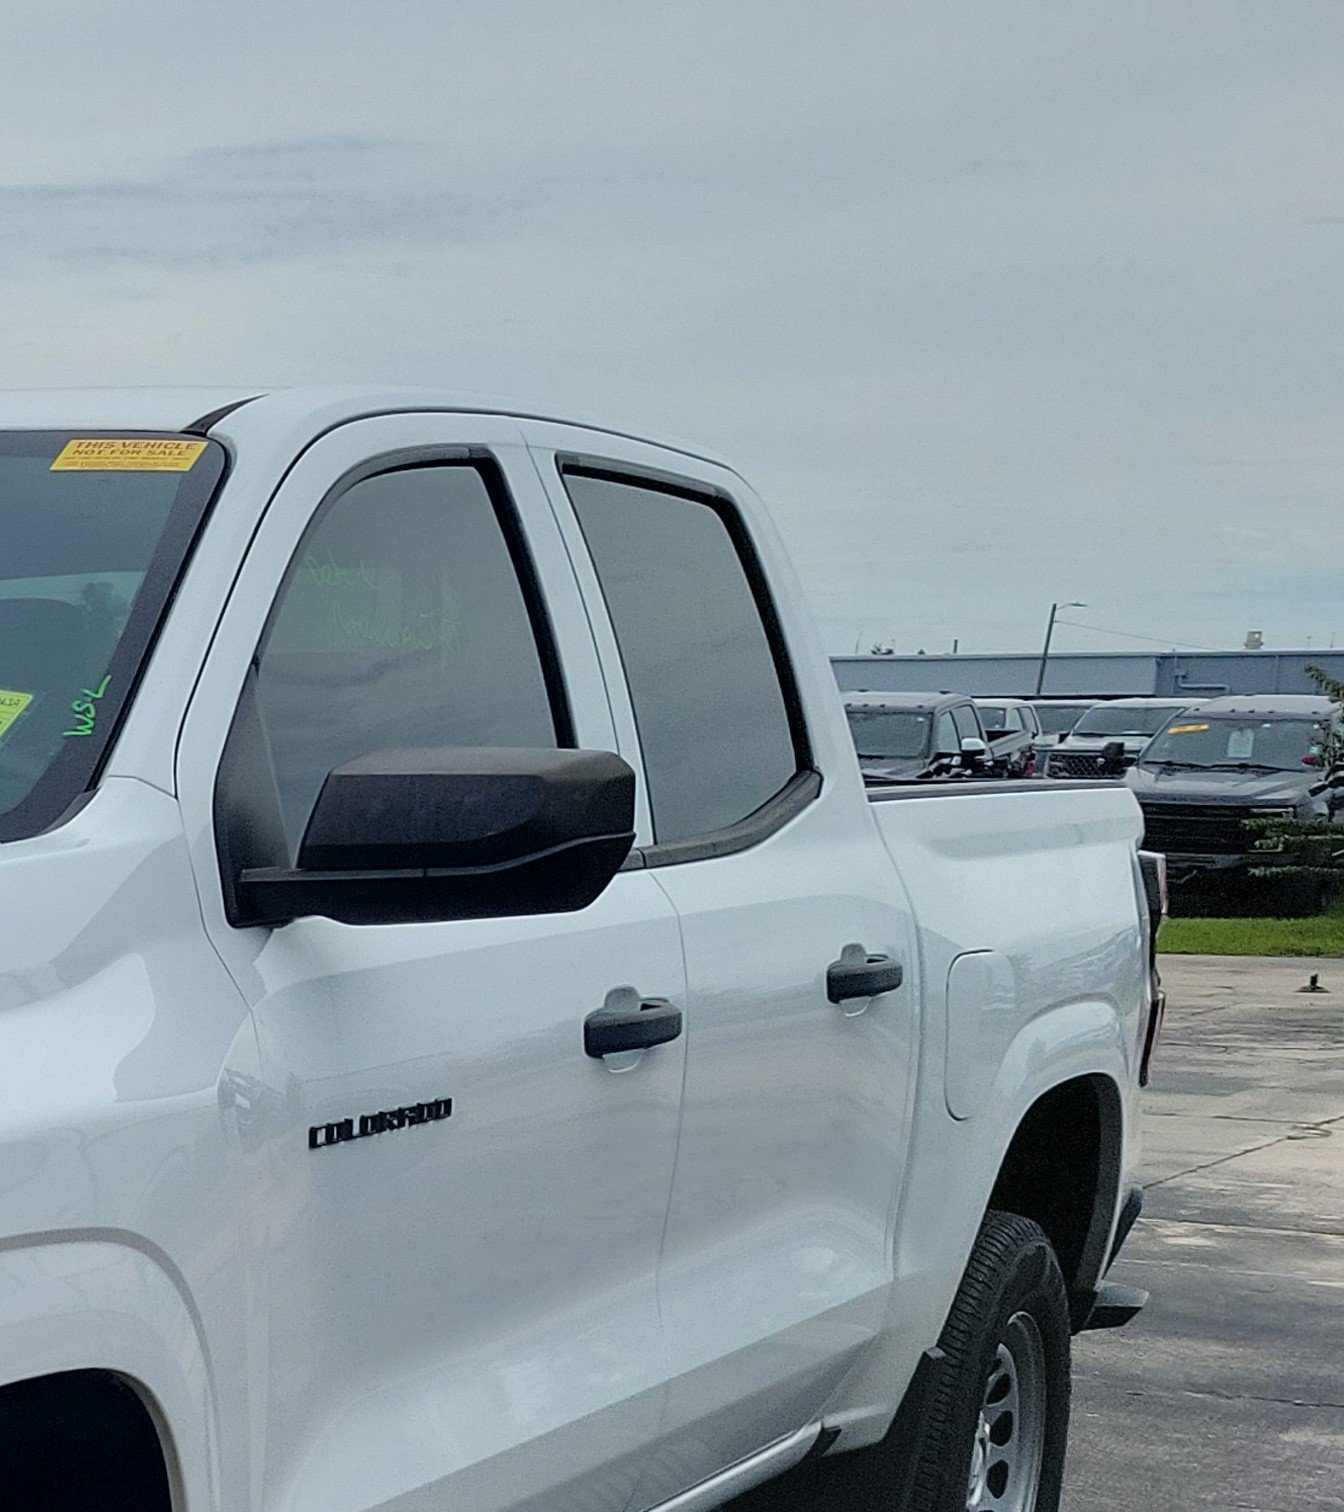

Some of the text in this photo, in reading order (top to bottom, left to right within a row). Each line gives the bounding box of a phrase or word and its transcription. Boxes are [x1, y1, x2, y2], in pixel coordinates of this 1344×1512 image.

[76, 441, 198, 450] THIS VEHICLE
[308, 1098, 453, 1150] COLORADO
